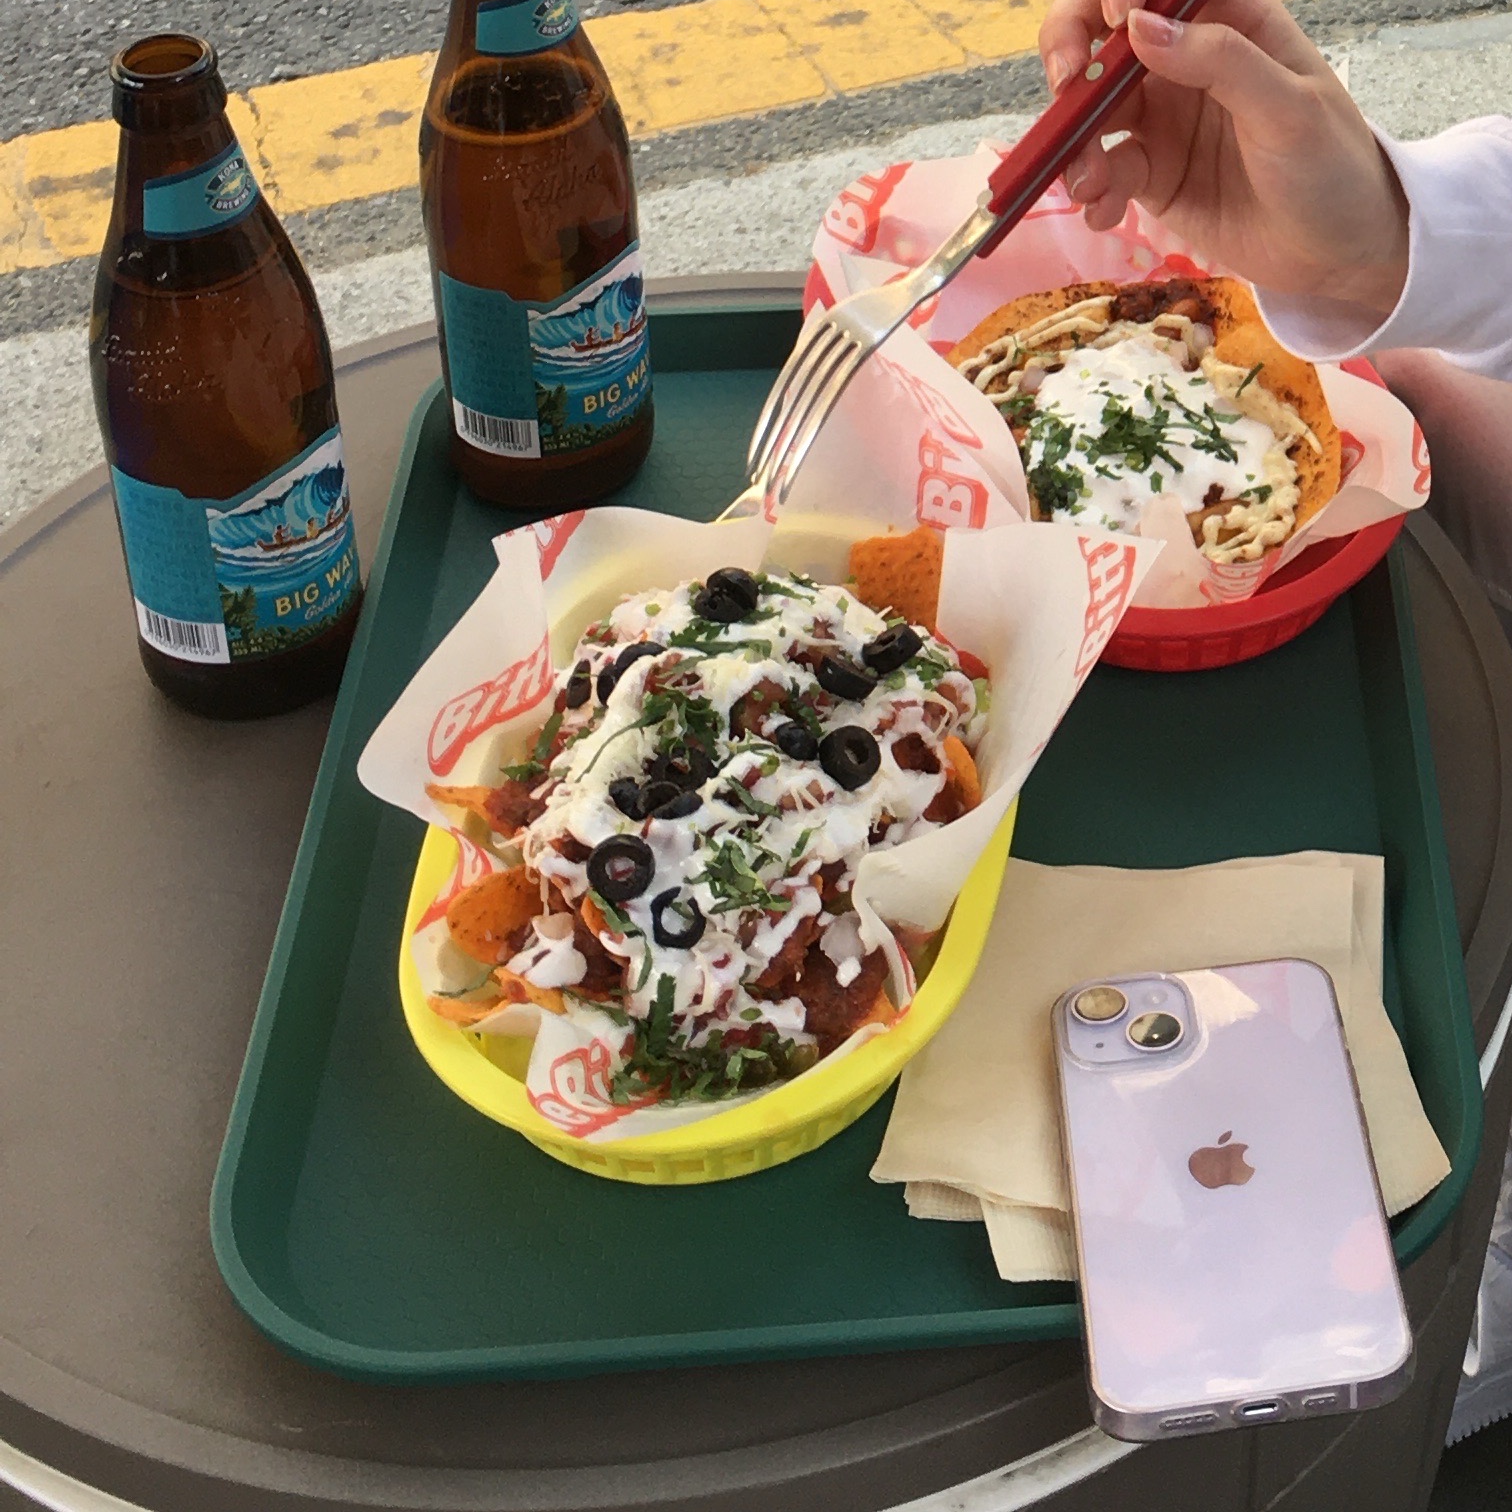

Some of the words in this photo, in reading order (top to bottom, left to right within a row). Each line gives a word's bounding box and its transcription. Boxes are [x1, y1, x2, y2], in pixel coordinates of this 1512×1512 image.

[217, 160, 239, 182] KONA
[583, 383, 620, 414] BIG
[275, 582, 320, 618] BIG
